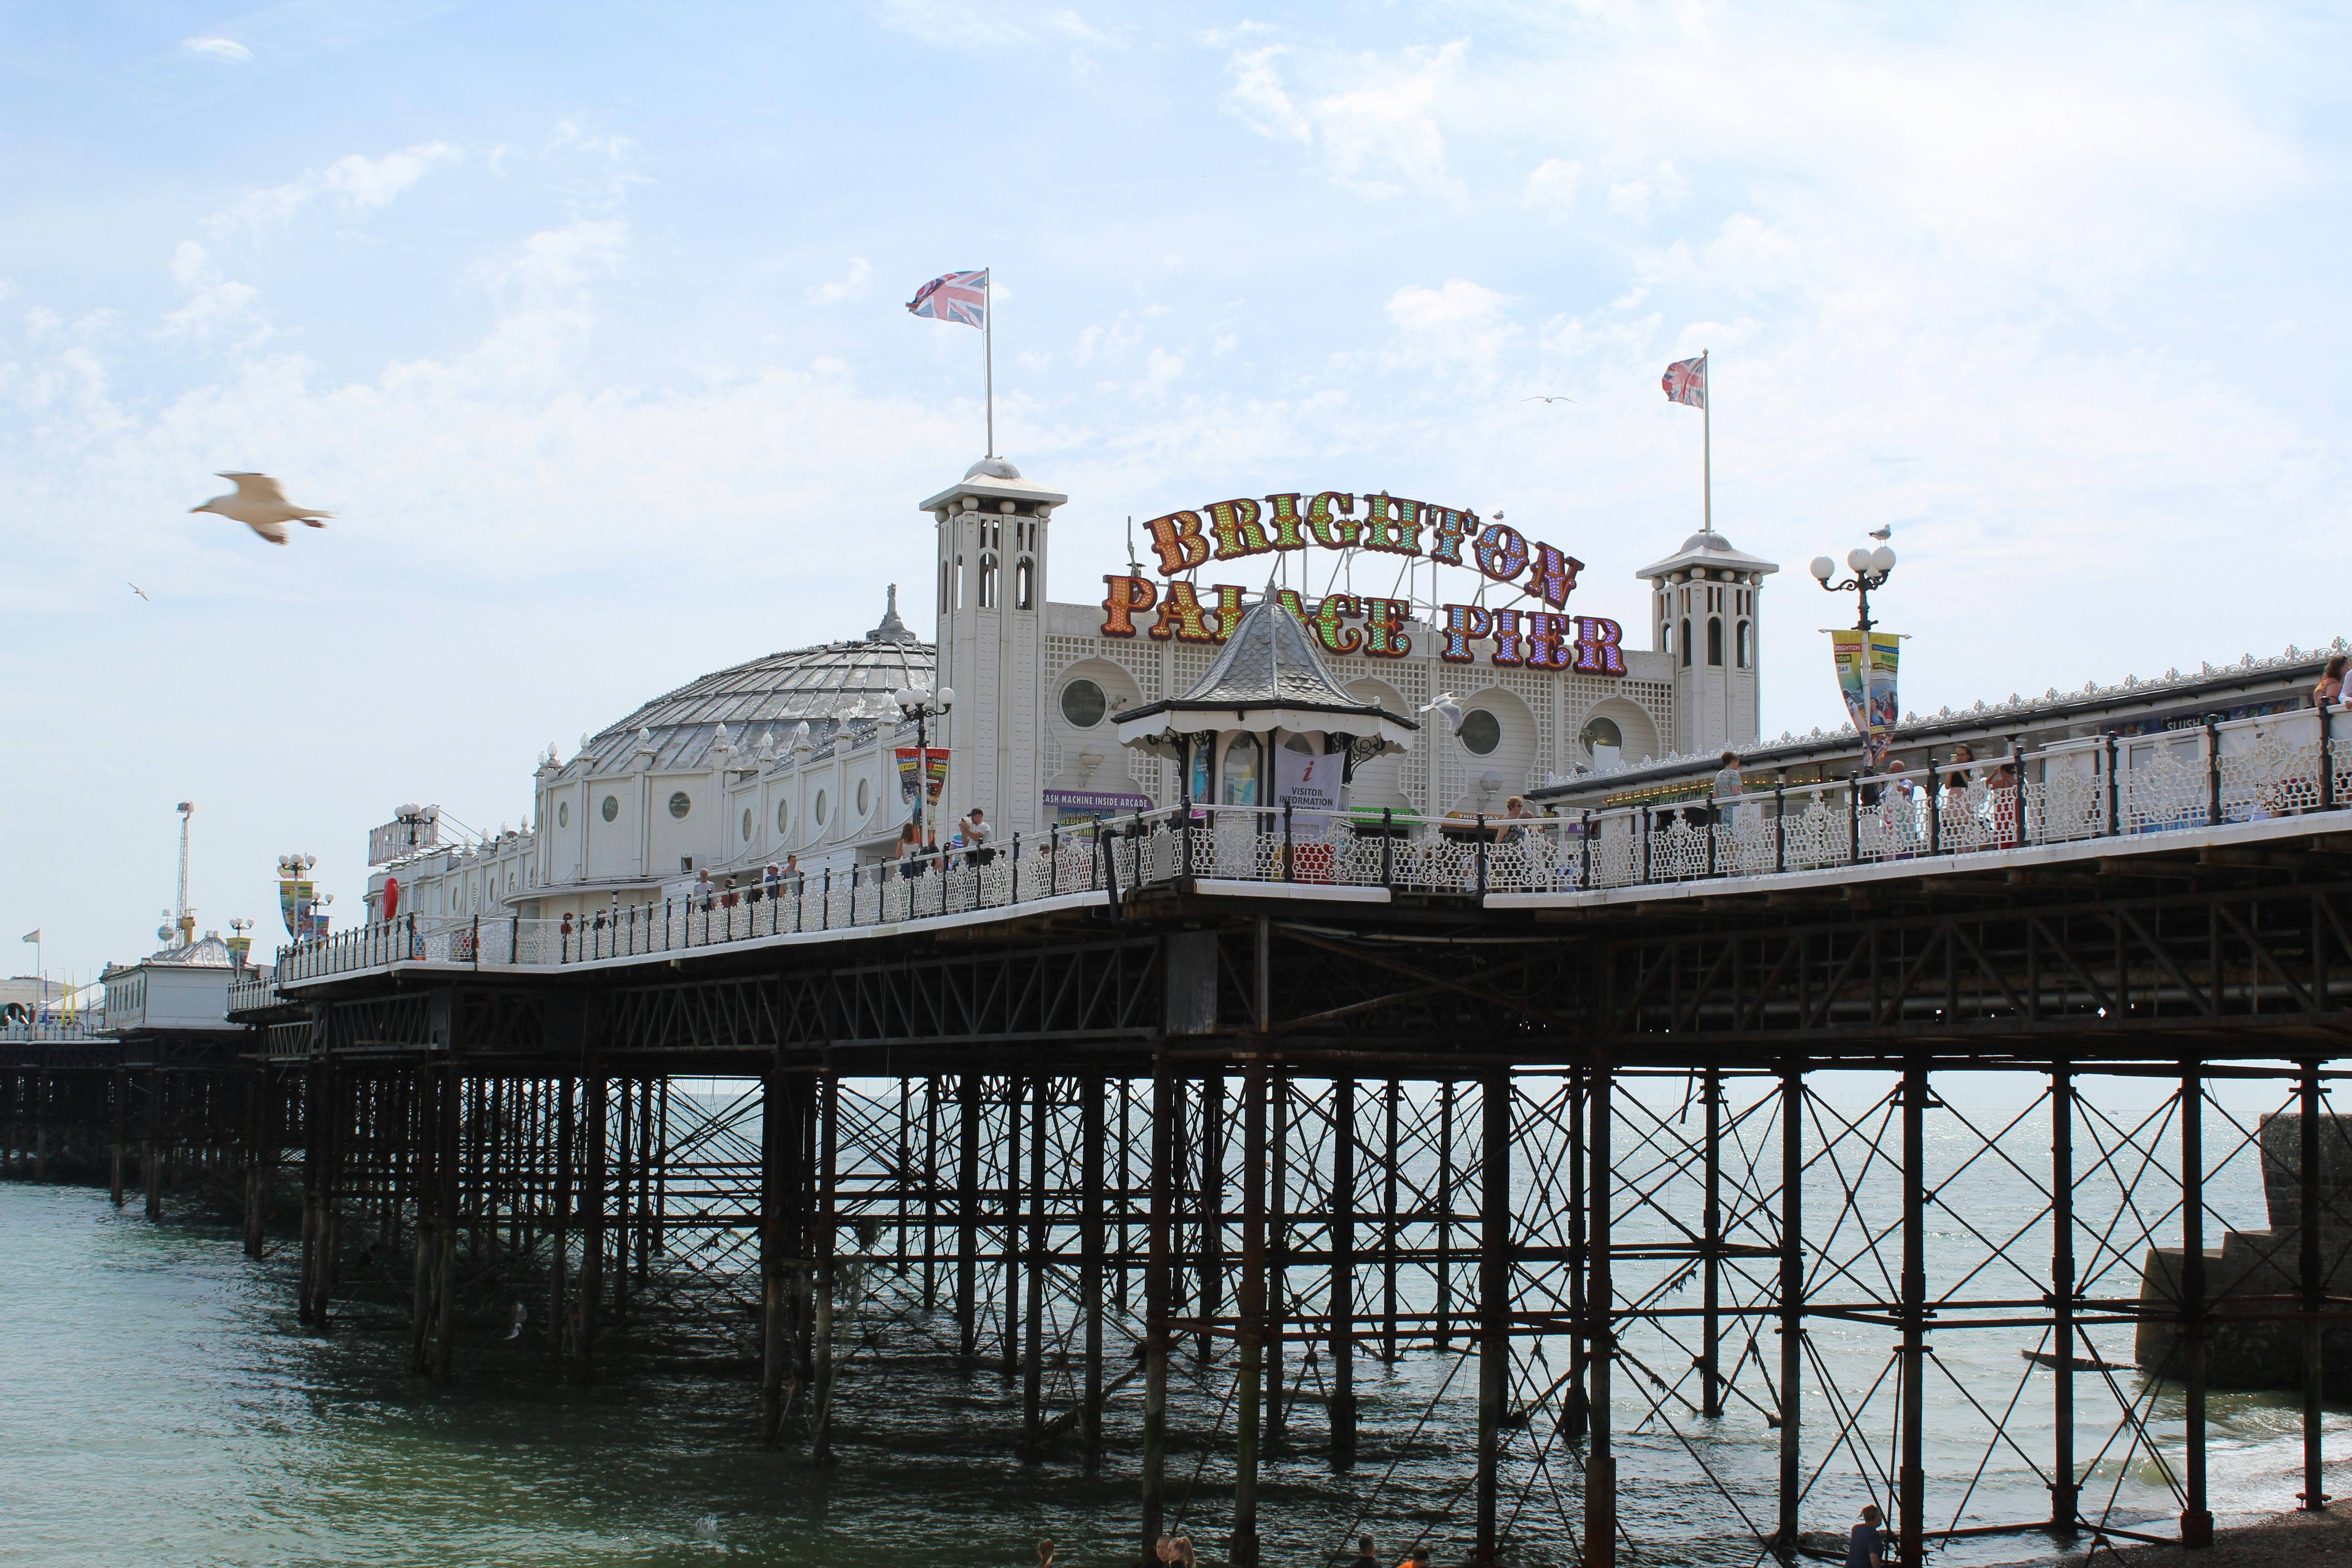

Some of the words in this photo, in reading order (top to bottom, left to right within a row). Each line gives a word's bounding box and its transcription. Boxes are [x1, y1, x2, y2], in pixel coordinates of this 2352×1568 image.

[1142, 491, 1585, 611] BRIGHTON
[1441, 603, 1627, 678] PIER
[2167, 718, 2200, 730] SLUSH
[1292, 787, 1323, 797] VISITOR
[1678, 788, 1702, 803] CREAM
[1061, 794, 1093, 805] MACHINE
[1095, 797, 1118, 806] INSIDE
[1120, 798, 1147, 808] ARCADE
[1279, 795, 1333, 806] INFORMATION
